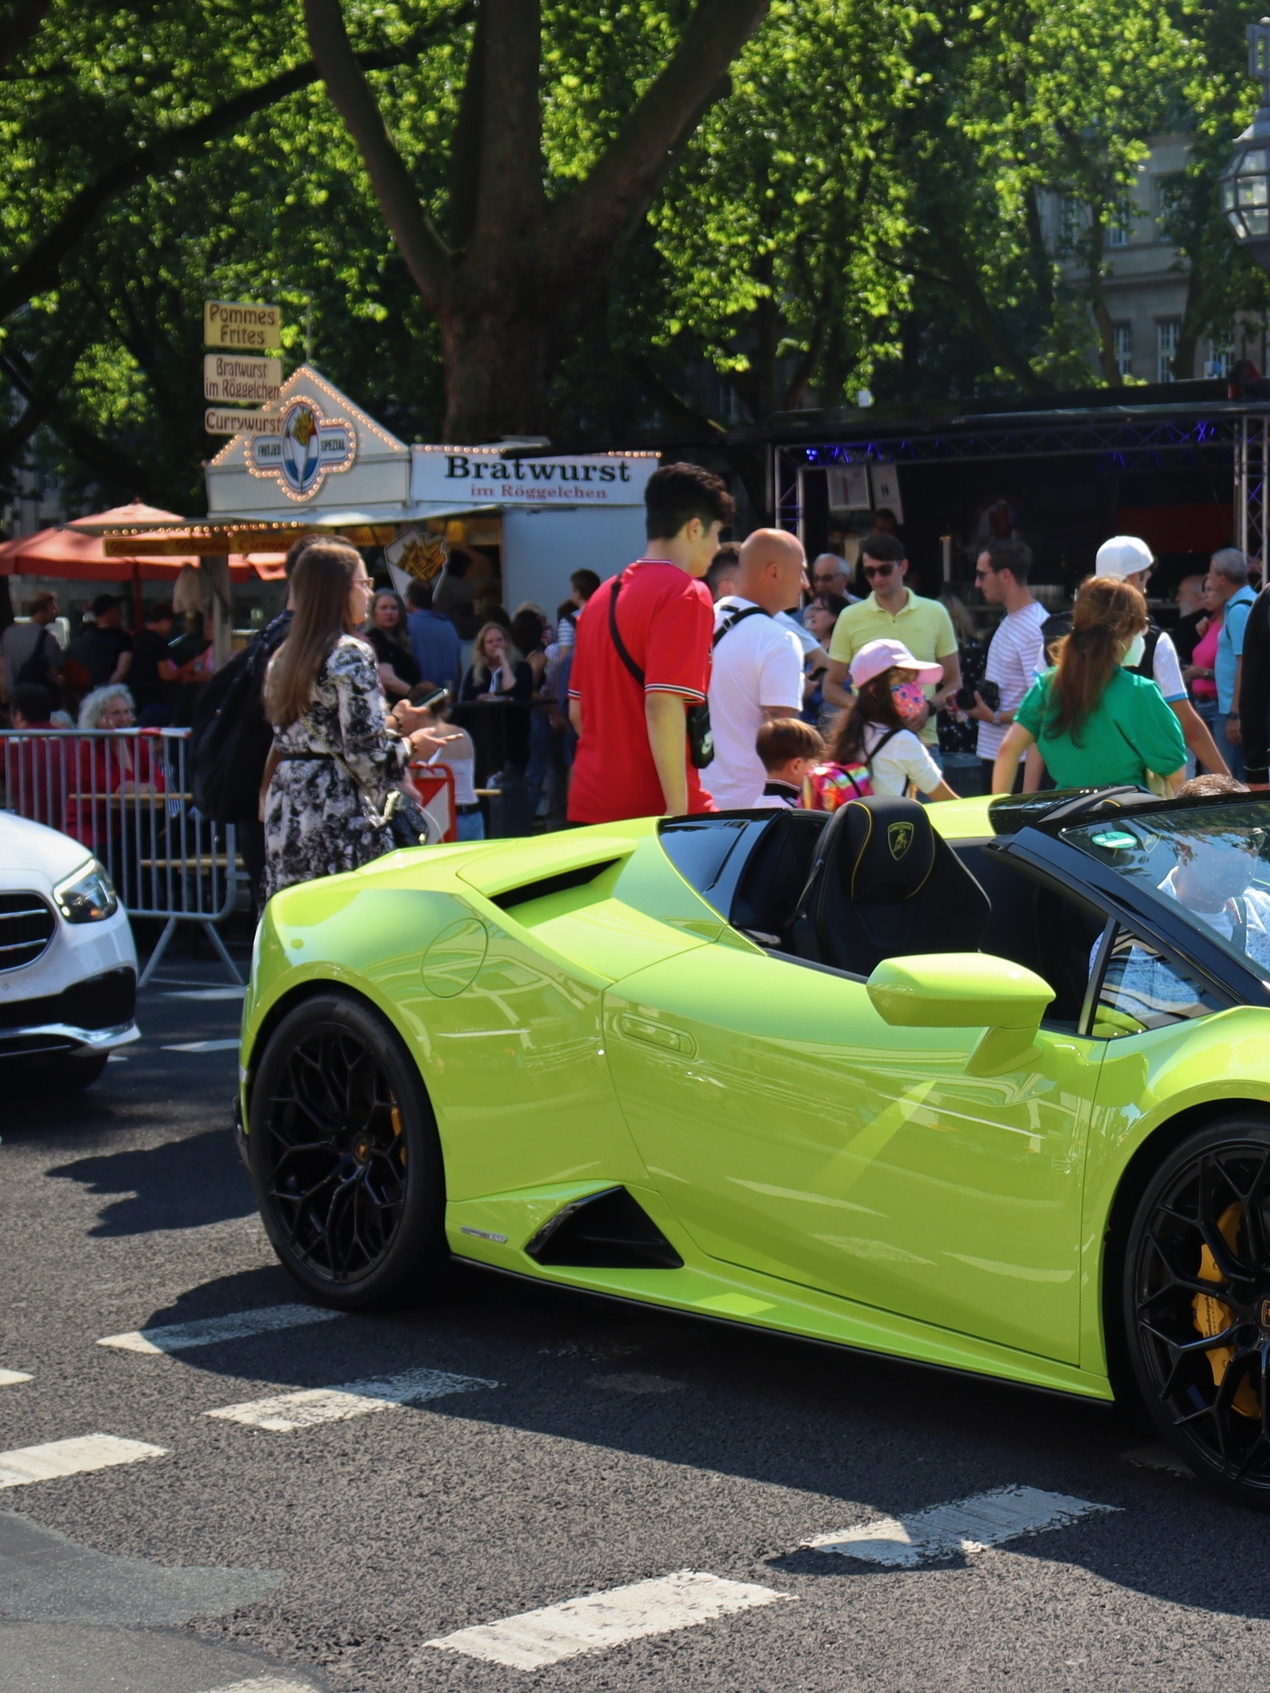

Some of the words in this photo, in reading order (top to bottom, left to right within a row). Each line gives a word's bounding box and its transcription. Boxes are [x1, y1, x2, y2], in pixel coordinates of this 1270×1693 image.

[209, 304, 276, 327] Pommes
[220, 324, 265, 345] Frites
[216, 358, 268, 379] Bratwurst
[205, 377, 219, 396] im
[222, 378, 280, 401] Röggelchen
[206, 411, 284, 435] Currywurst
[320, 438, 347, 452] SPEZIAL
[444, 455, 631, 483] Bratwurst
[470, 484, 494, 497] im
[501, 484, 608, 500] Röggelchen
